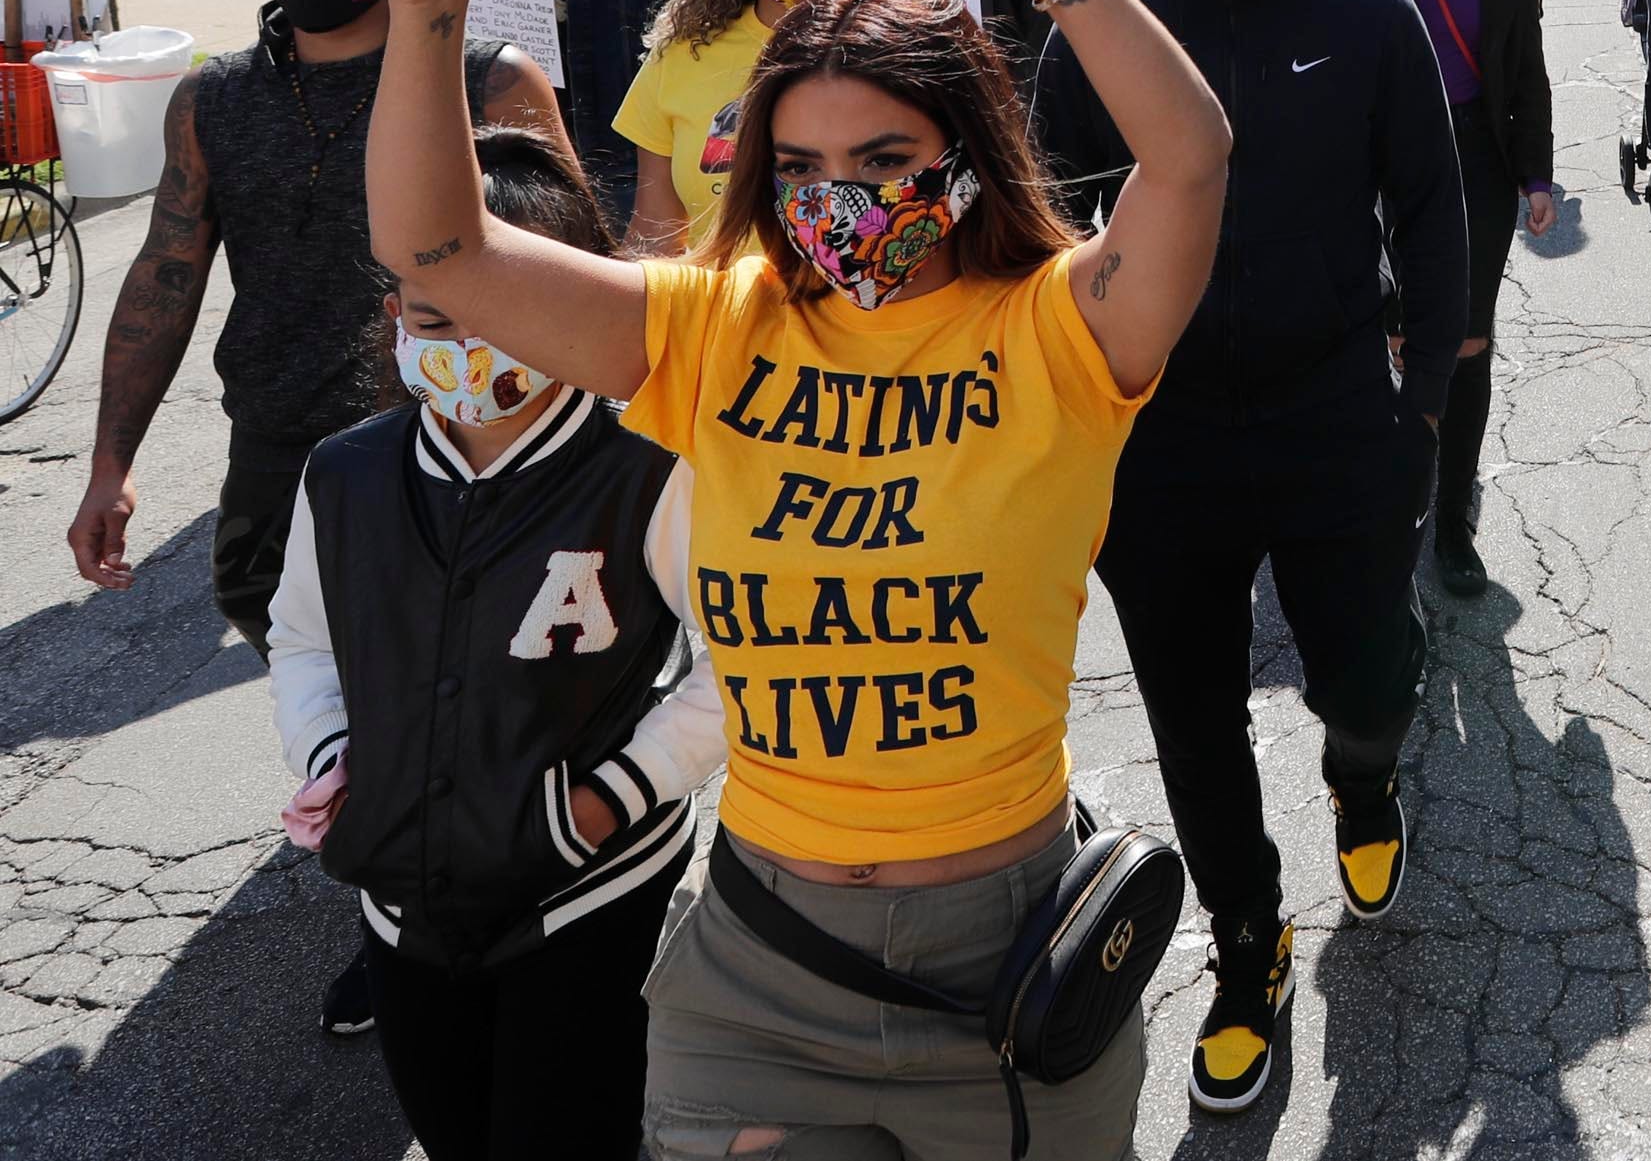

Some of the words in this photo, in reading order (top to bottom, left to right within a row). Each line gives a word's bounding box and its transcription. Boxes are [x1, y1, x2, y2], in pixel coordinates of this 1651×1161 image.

[494, 18, 515, 29] ERIC
[517, 22, 552, 35] GARNER
[751, 471, 925, 550] FOR
[508, 550, 619, 660] A
[697, 566, 989, 648] BLACK
[724, 664, 979, 760] LIVES
